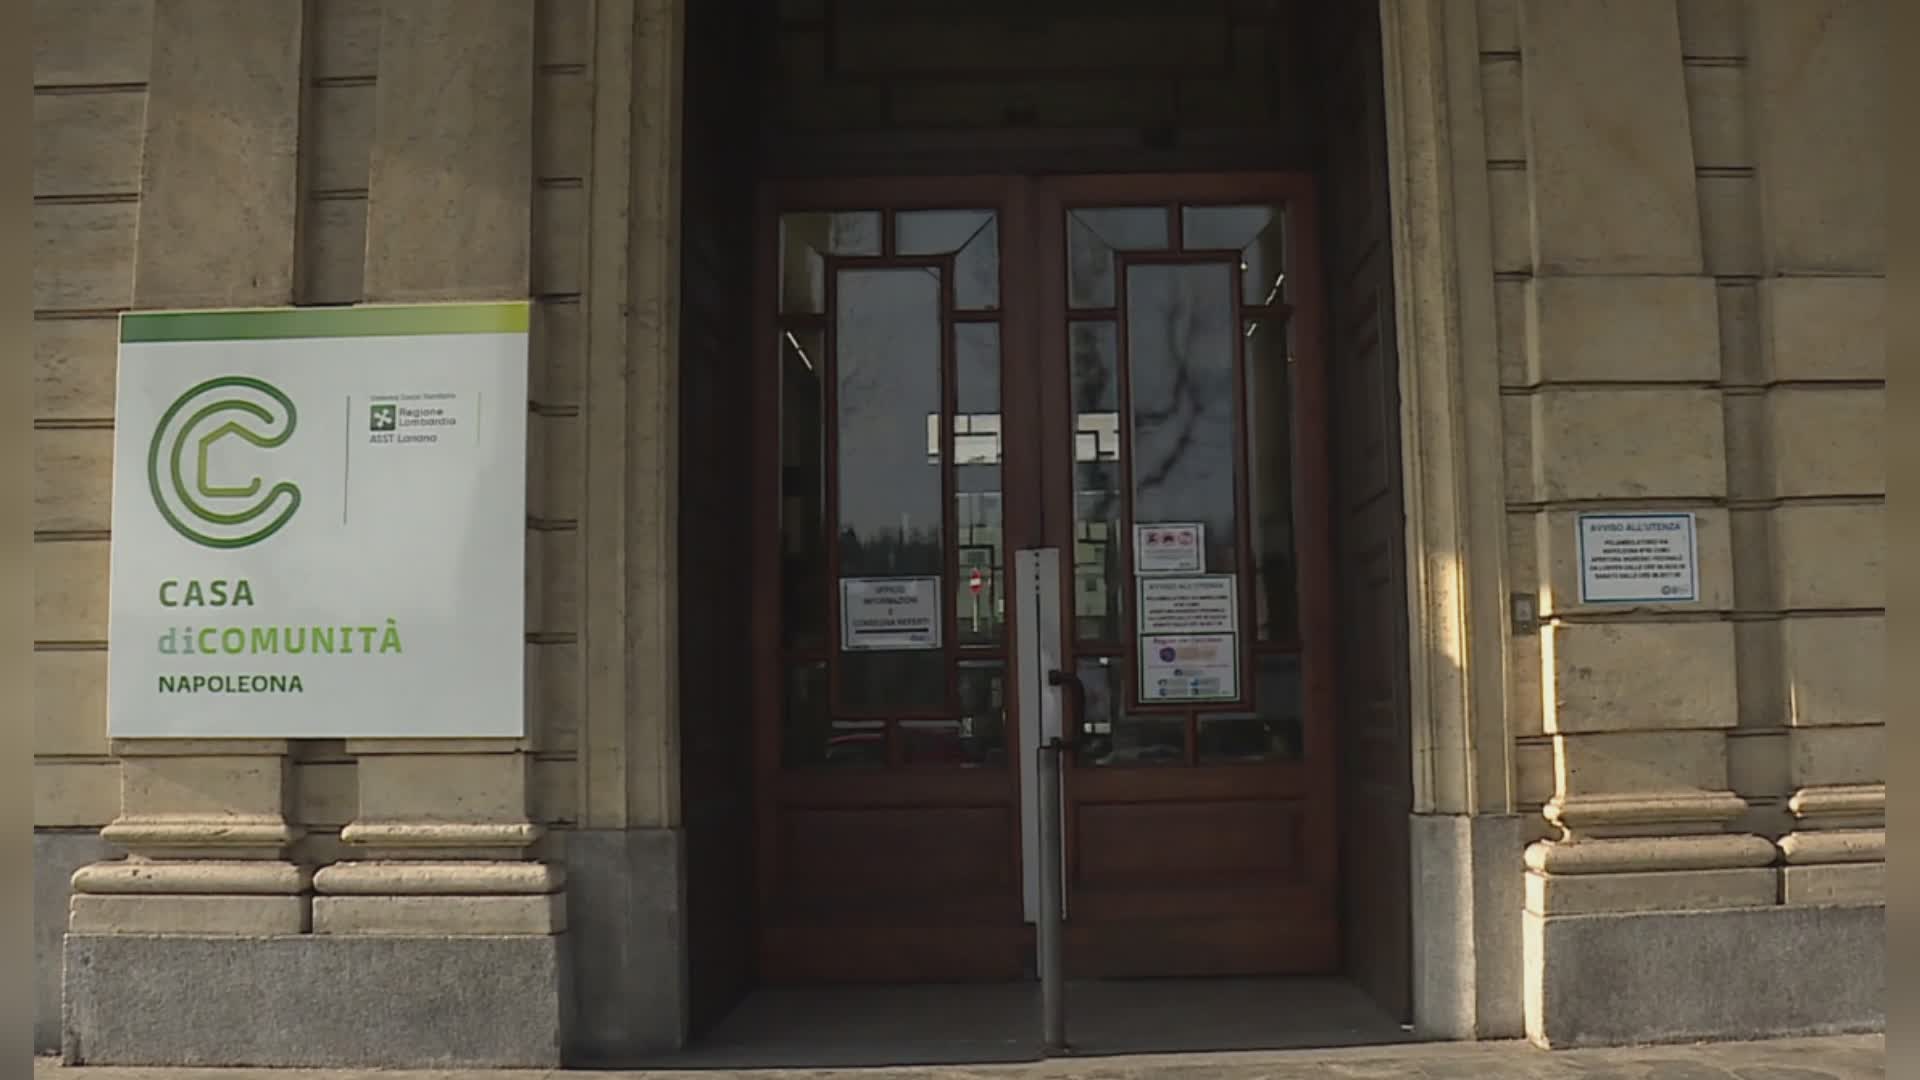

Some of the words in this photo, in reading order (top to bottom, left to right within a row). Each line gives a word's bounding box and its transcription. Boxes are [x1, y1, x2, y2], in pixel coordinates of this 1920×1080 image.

[400, 408, 443, 418] Regione
[400, 417, 456, 427] Lombardia
[159, 579, 254, 607] CASA
[158, 675, 303, 693] NAPOLEONA
